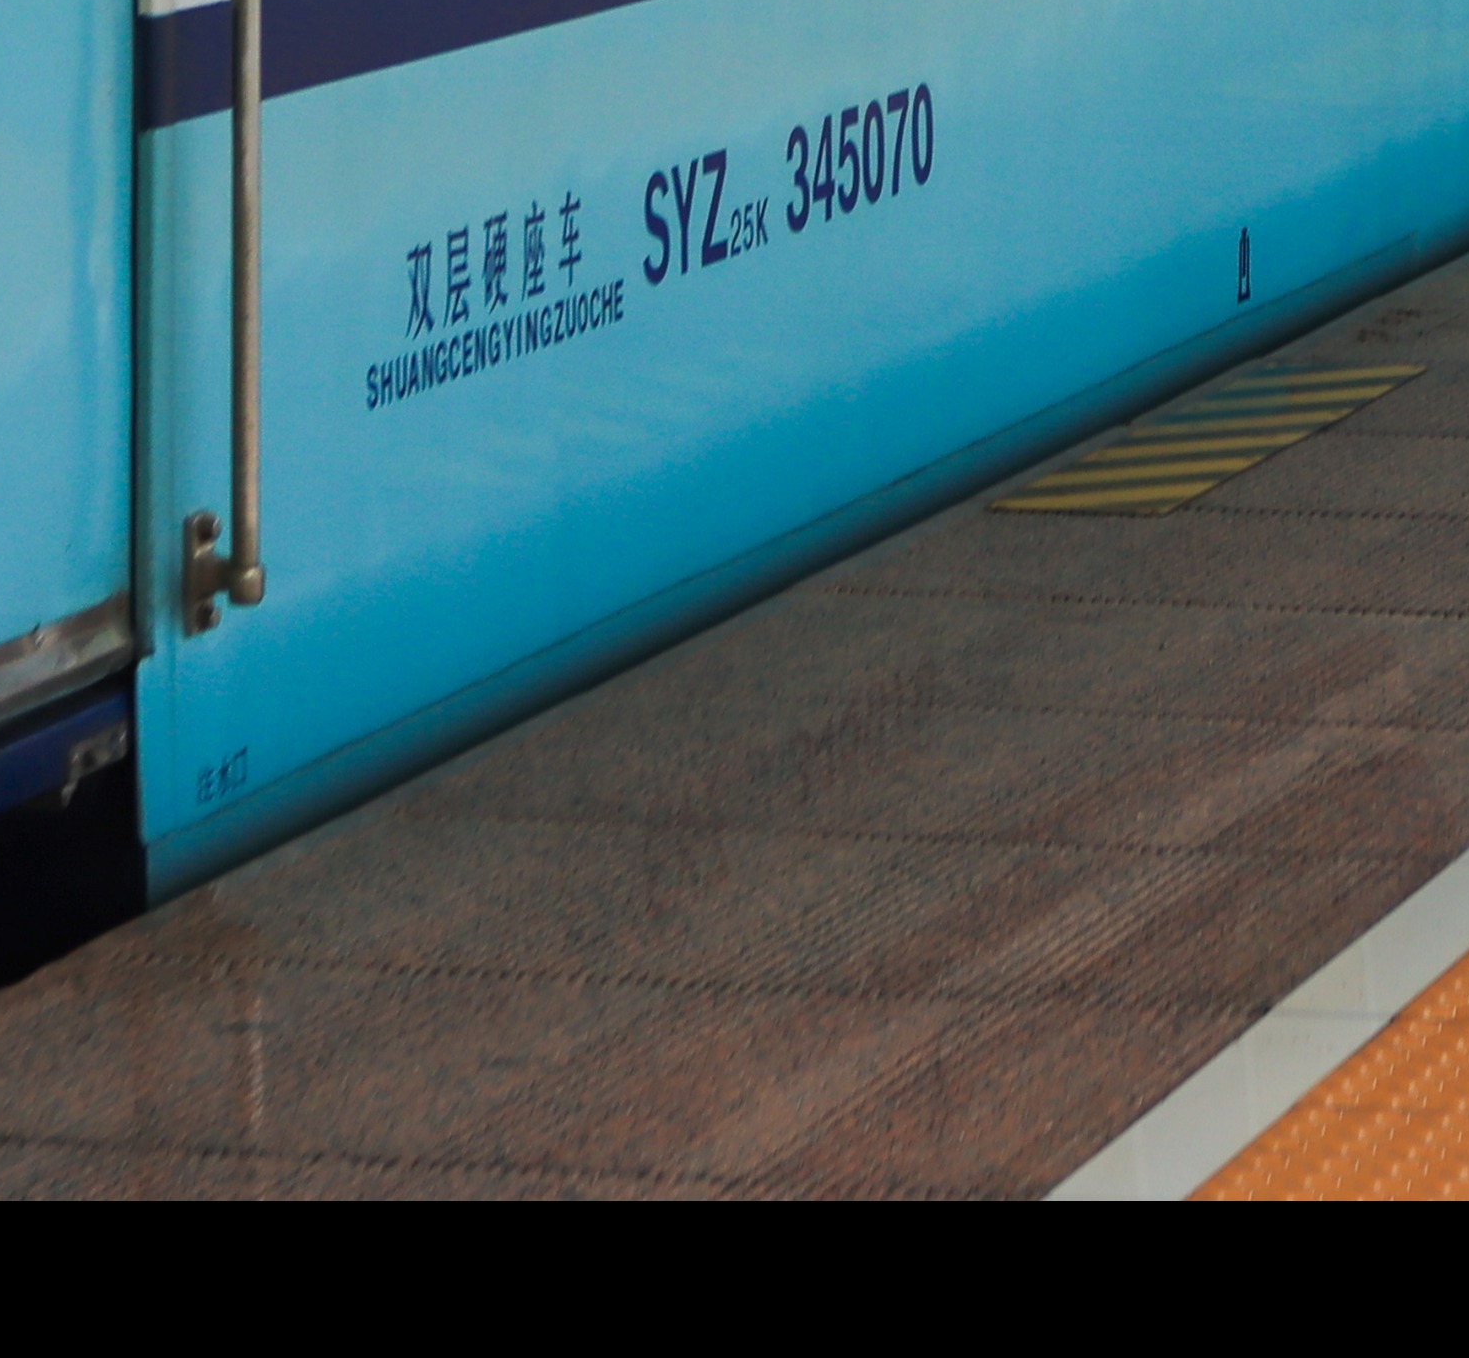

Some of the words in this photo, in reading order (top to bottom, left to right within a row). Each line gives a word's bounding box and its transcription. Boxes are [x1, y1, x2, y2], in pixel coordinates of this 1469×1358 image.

[406, 190, 582, 340] 双层硬座车
[786, 83, 934, 232] 345070
[367, 279, 625, 411] SHUANGCENGYINGZUOCHE
